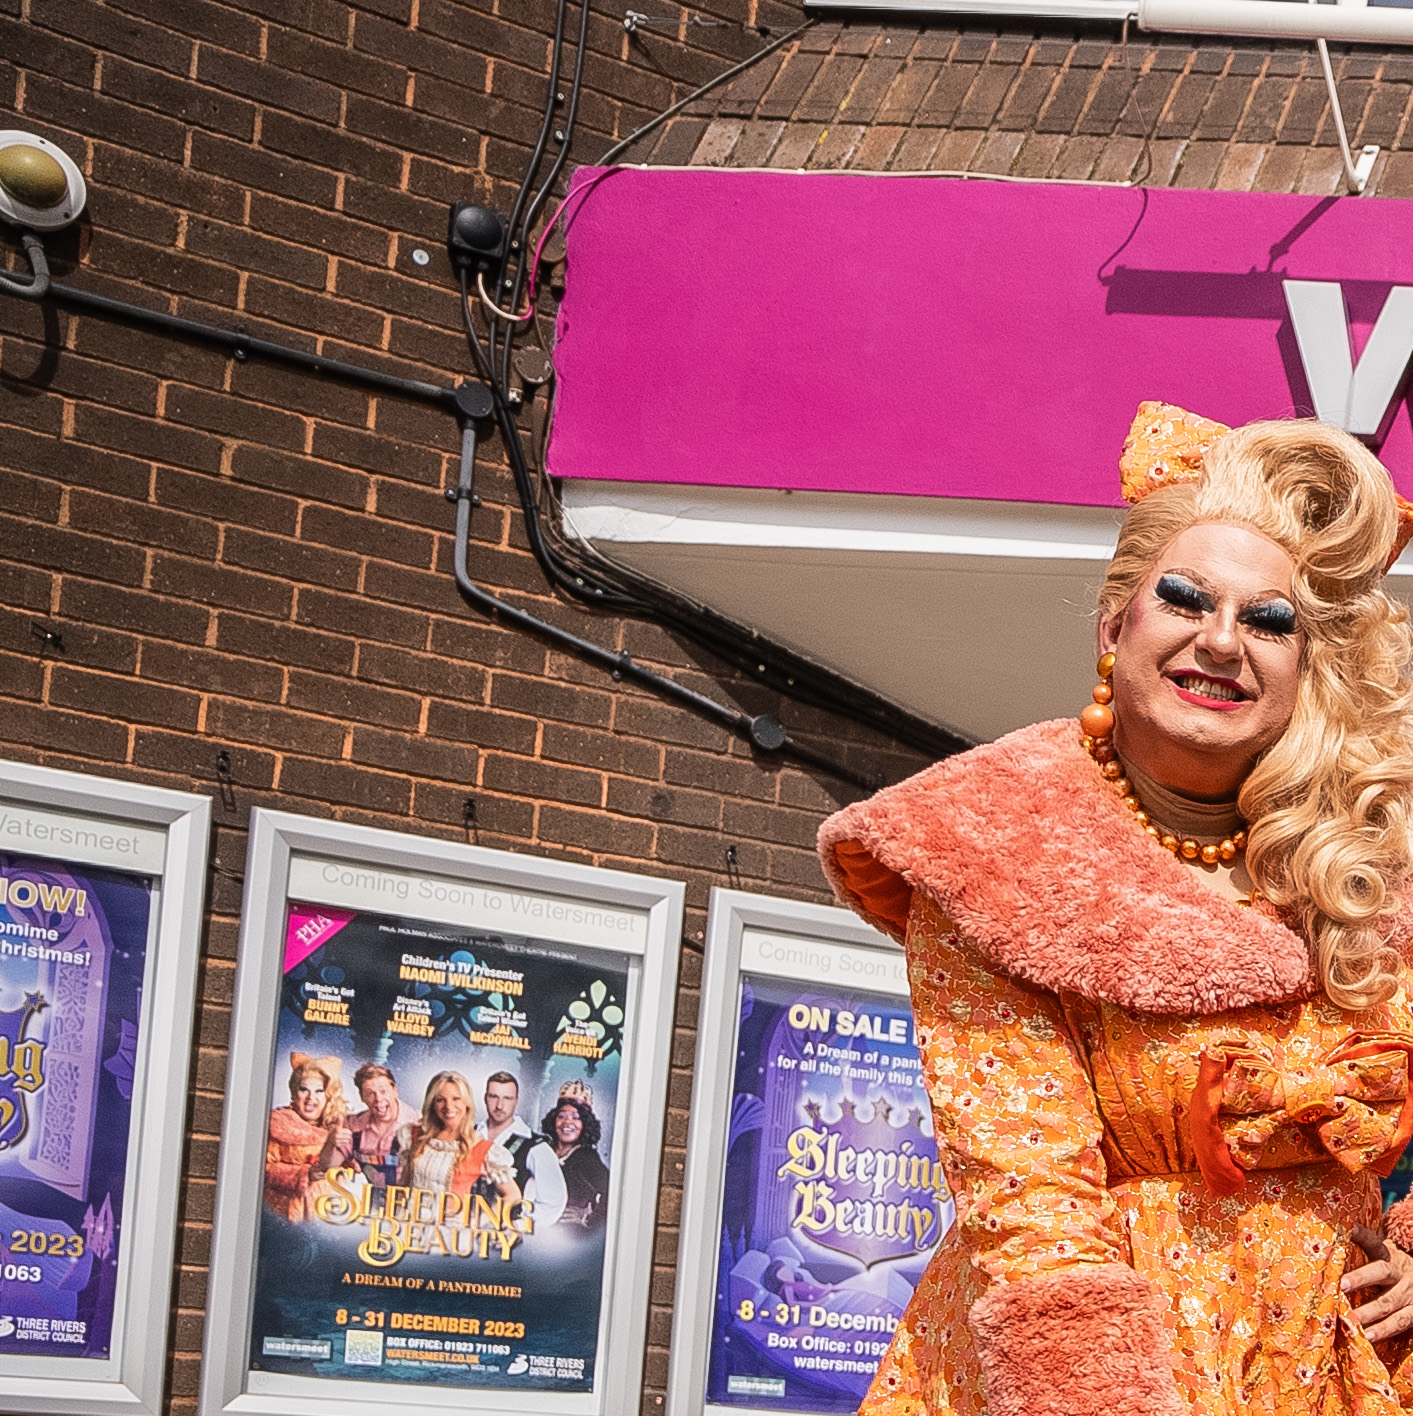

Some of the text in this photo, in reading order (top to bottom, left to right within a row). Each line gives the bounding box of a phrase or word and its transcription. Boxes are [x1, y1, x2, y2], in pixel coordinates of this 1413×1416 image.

[322, 864, 636, 932] Coming Soon to Watersmeet
[0, 939, 91, 966] hristmas!
[758, 941, 831, 972] Coming
[839, 953, 887, 977] Soon
[400, 965, 524, 996] NAOMI WILKINSON
[402, 953, 524, 981] Children's TV Presenter
[304, 1010, 350, 1026] GALORE
[307, 999, 349, 1014] BUNNY
[394, 1011, 429, 1025] LLOYD
[386, 1020, 435, 1037] WARBEY
[788, 1003, 830, 1032] ON
[835, 1010, 908, 1044] SALE
[470, 1031, 531, 1049] MCDOWALL
[803, 1042, 814, 1055] A
[817, 1043, 861, 1062] Dream
[864, 1051, 879, 1064] of
[881, 1054, 889, 1065] a
[777, 1055, 797, 1069] for
[800, 1058, 816, 1072] all
[820, 1061, 841, 1075] the
[844, 1064, 885, 1084] family
[888, 1070, 913, 1085] this
[777, 1125, 952, 1202] Sleeping
[314, 1167, 534, 1233] SLEEPING
[792, 1181, 934, 1252] Beauty
[10, 1229, 84, 1257] 2023
[358, 1217, 520, 1266] BEAUTY
[341, 1272, 522, 1298] A DREAM OF A PANTOMIME!
[16, 1317, 87, 1333] THREE RIVERS
[336, 1308, 348, 1325] 8
[364, 1311, 385, 1327] 31
[391, 1312, 480, 1335] DECEMBER
[484, 1320, 525, 1338] 2023
[739, 1299, 754, 1321] 8
[775, 1303, 800, 1325] 31
[809, 1305, 900, 1334] Decemb
[265, 1341, 328, 1353] watersmeet
[387, 1336, 407, 1348] BOX
[408, 1338, 442, 1351] OFFICE:
[767, 1332, 889, 1357] Box Office: 0192
[794, 1356, 880, 1375] watersmeet
